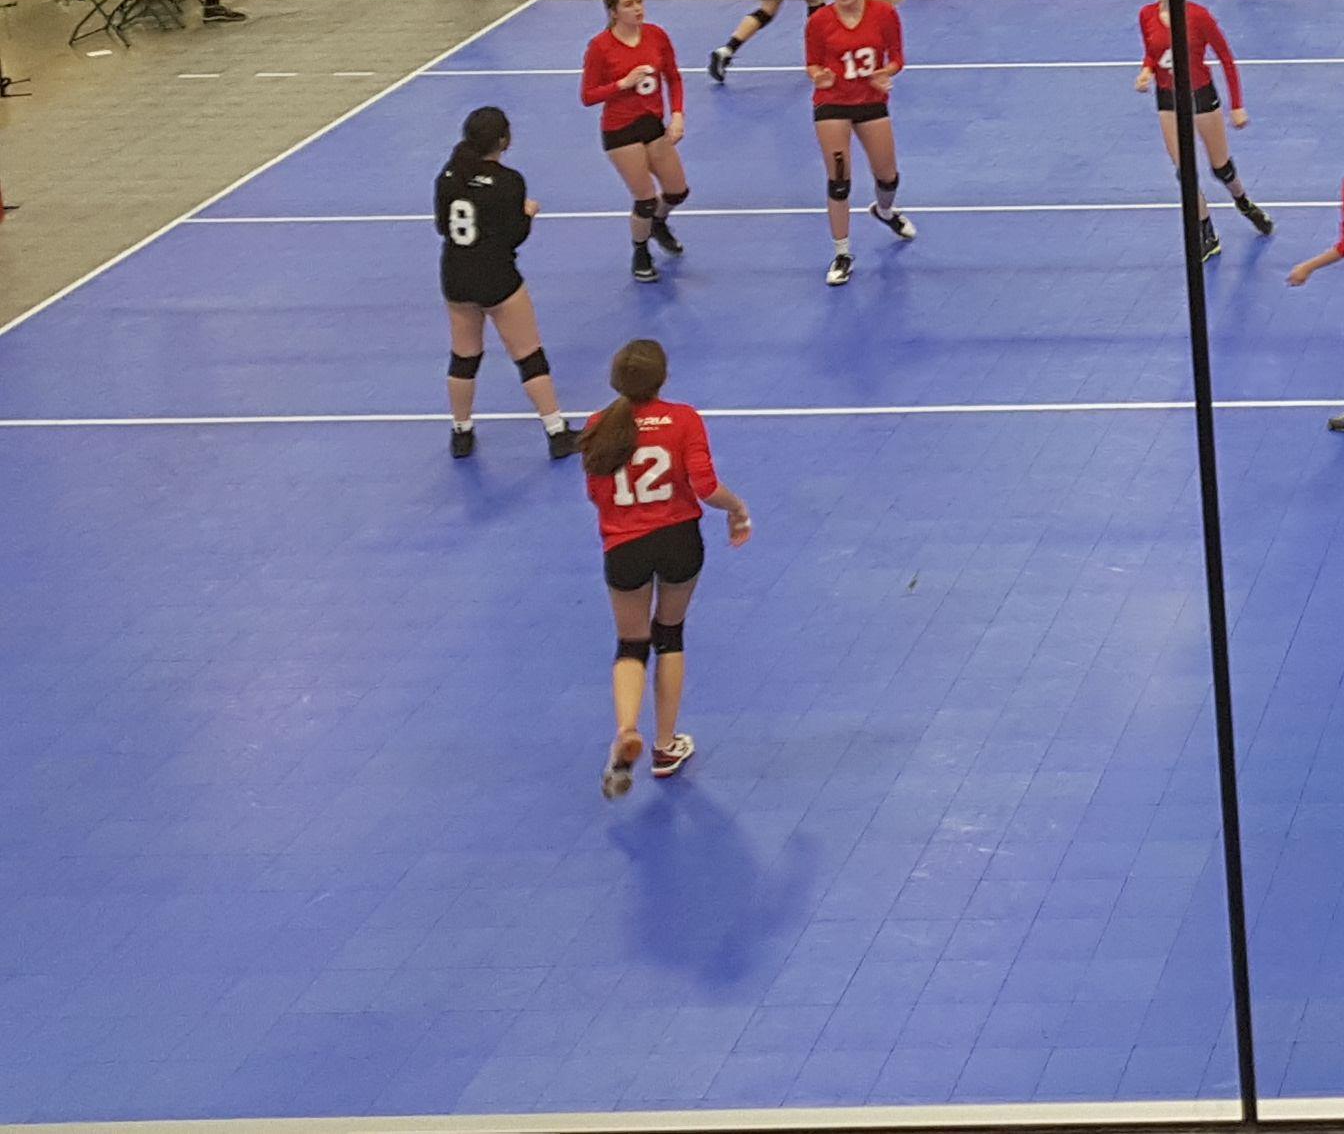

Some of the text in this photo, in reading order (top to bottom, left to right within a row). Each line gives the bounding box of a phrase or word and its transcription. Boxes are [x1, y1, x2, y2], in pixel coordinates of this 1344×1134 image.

[841, 46, 878, 80] 13
[449, 199, 476, 246] 8
[613, 446, 673, 506] 12
